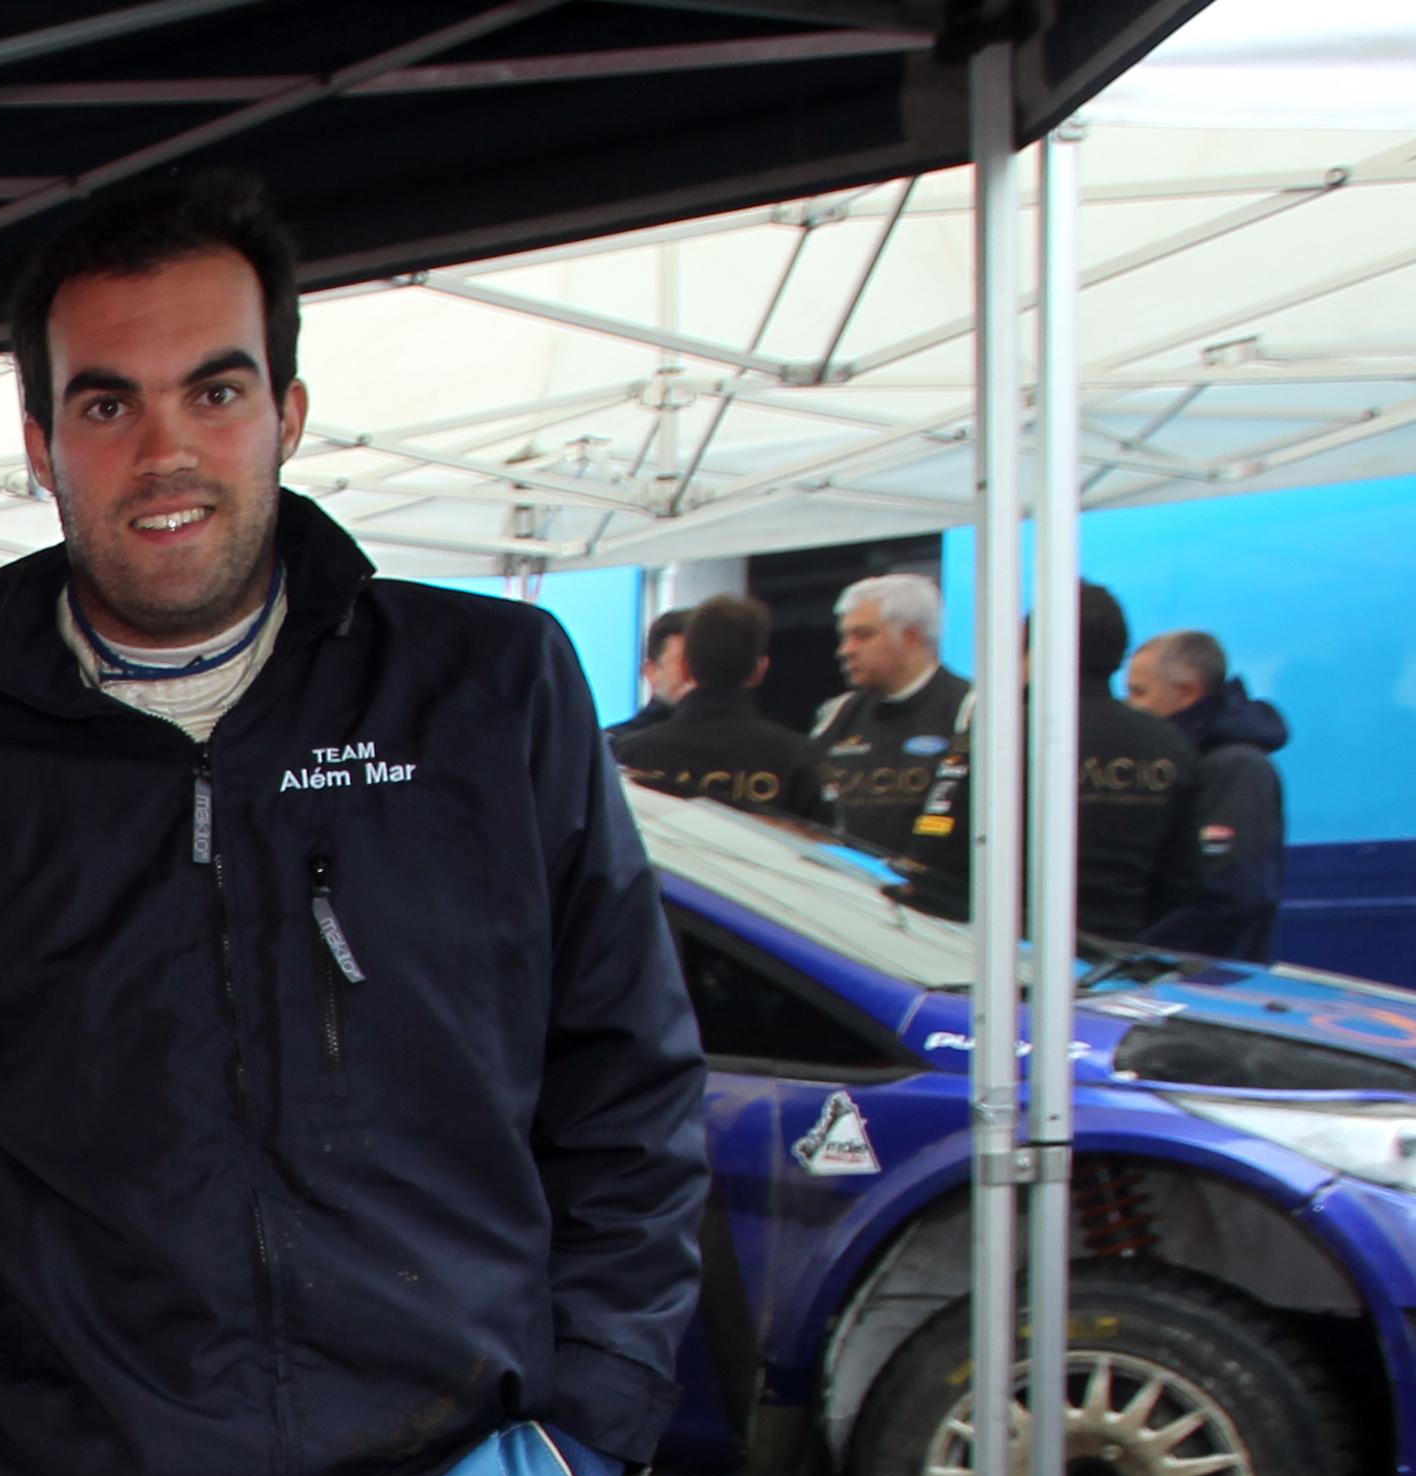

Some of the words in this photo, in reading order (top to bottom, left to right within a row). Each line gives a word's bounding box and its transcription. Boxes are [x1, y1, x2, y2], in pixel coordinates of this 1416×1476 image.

[312, 741, 376, 763] TEAM
[280, 767, 351, 792] Além
[365, 761, 416, 785] Mar
